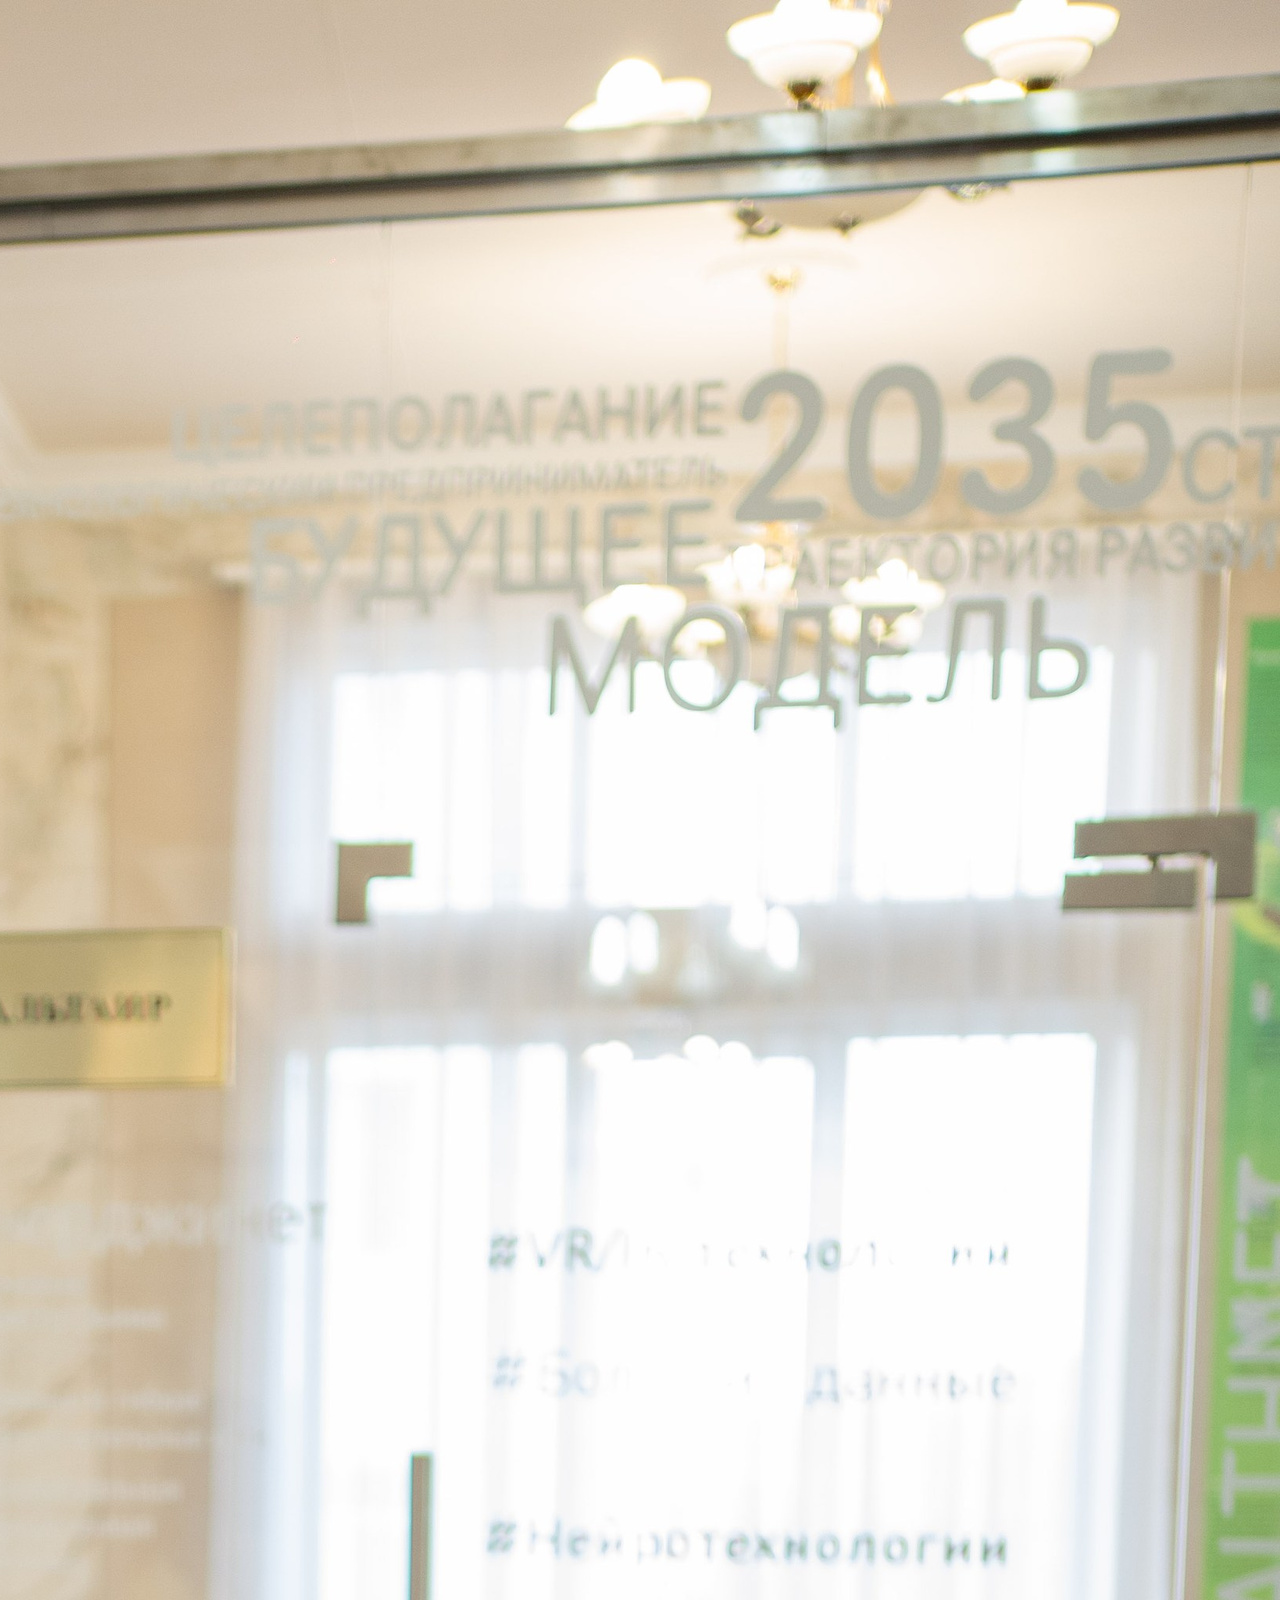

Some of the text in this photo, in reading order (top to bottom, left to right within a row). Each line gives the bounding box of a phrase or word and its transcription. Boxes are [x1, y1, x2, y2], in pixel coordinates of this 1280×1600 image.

[170, 378, 730, 467] ЦЕЛЕПОЛАГАНИЕ
[735, 346, 1174, 522] 2035
[251, 497, 715, 615] БУДУЩЕЕ
[724, 526, 1080, 590] РАЕКТОРИЯ
[548, 595, 1091, 732] МОДЕЛЬ
